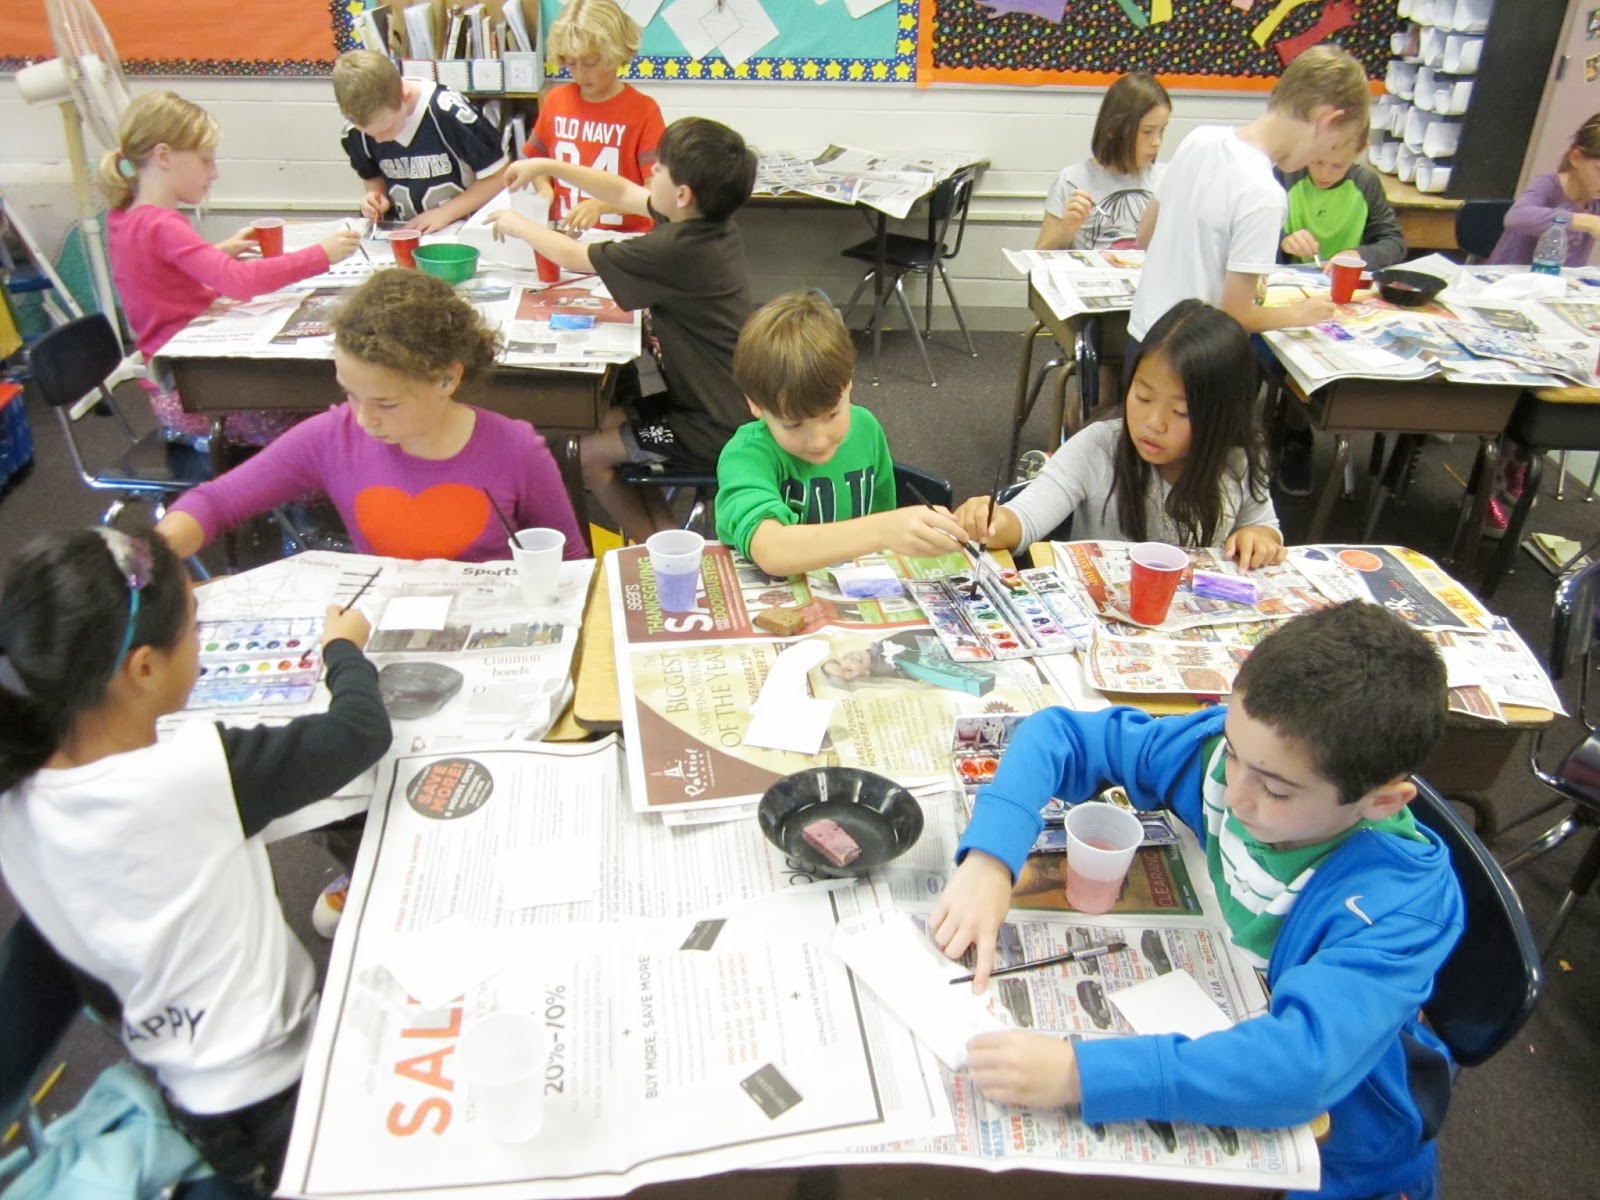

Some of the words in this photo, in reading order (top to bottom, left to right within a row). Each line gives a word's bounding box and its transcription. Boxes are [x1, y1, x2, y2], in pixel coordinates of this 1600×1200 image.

[554, 116, 580, 140] OLD
[581, 120, 627, 147] NAVY
[462, 567, 519, 577] Sports
[701, 554, 729, 621] DOORBUSTERS
[625, 584, 643, 611] sears
[637, 555, 665, 634] THANKSGIVING
[483, 654, 541, 666] Common
[491, 666, 529, 678] bonds
[706, 647, 729, 681] YEAR
[661, 652, 691, 714] BIGGEST
[710, 684, 736, 721] THE
[716, 722, 742, 749] OF
[859, 721, 877, 767] NOVEMBER
[416, 766, 449, 805] SAVE
[684, 747, 700, 798] Patriot
[1142, 851, 1172, 908] CLEARANC
[639, 954, 649, 991] MORE
[1210, 980, 1226, 999] KIA
[641, 994, 654, 1028] SAVE
[386, 993, 466, 1137] SAL
[645, 1030, 656, 1071] MORE,
[645, 1074, 657, 1100] BUY
[1010, 1115, 1026, 1150] SAVE
